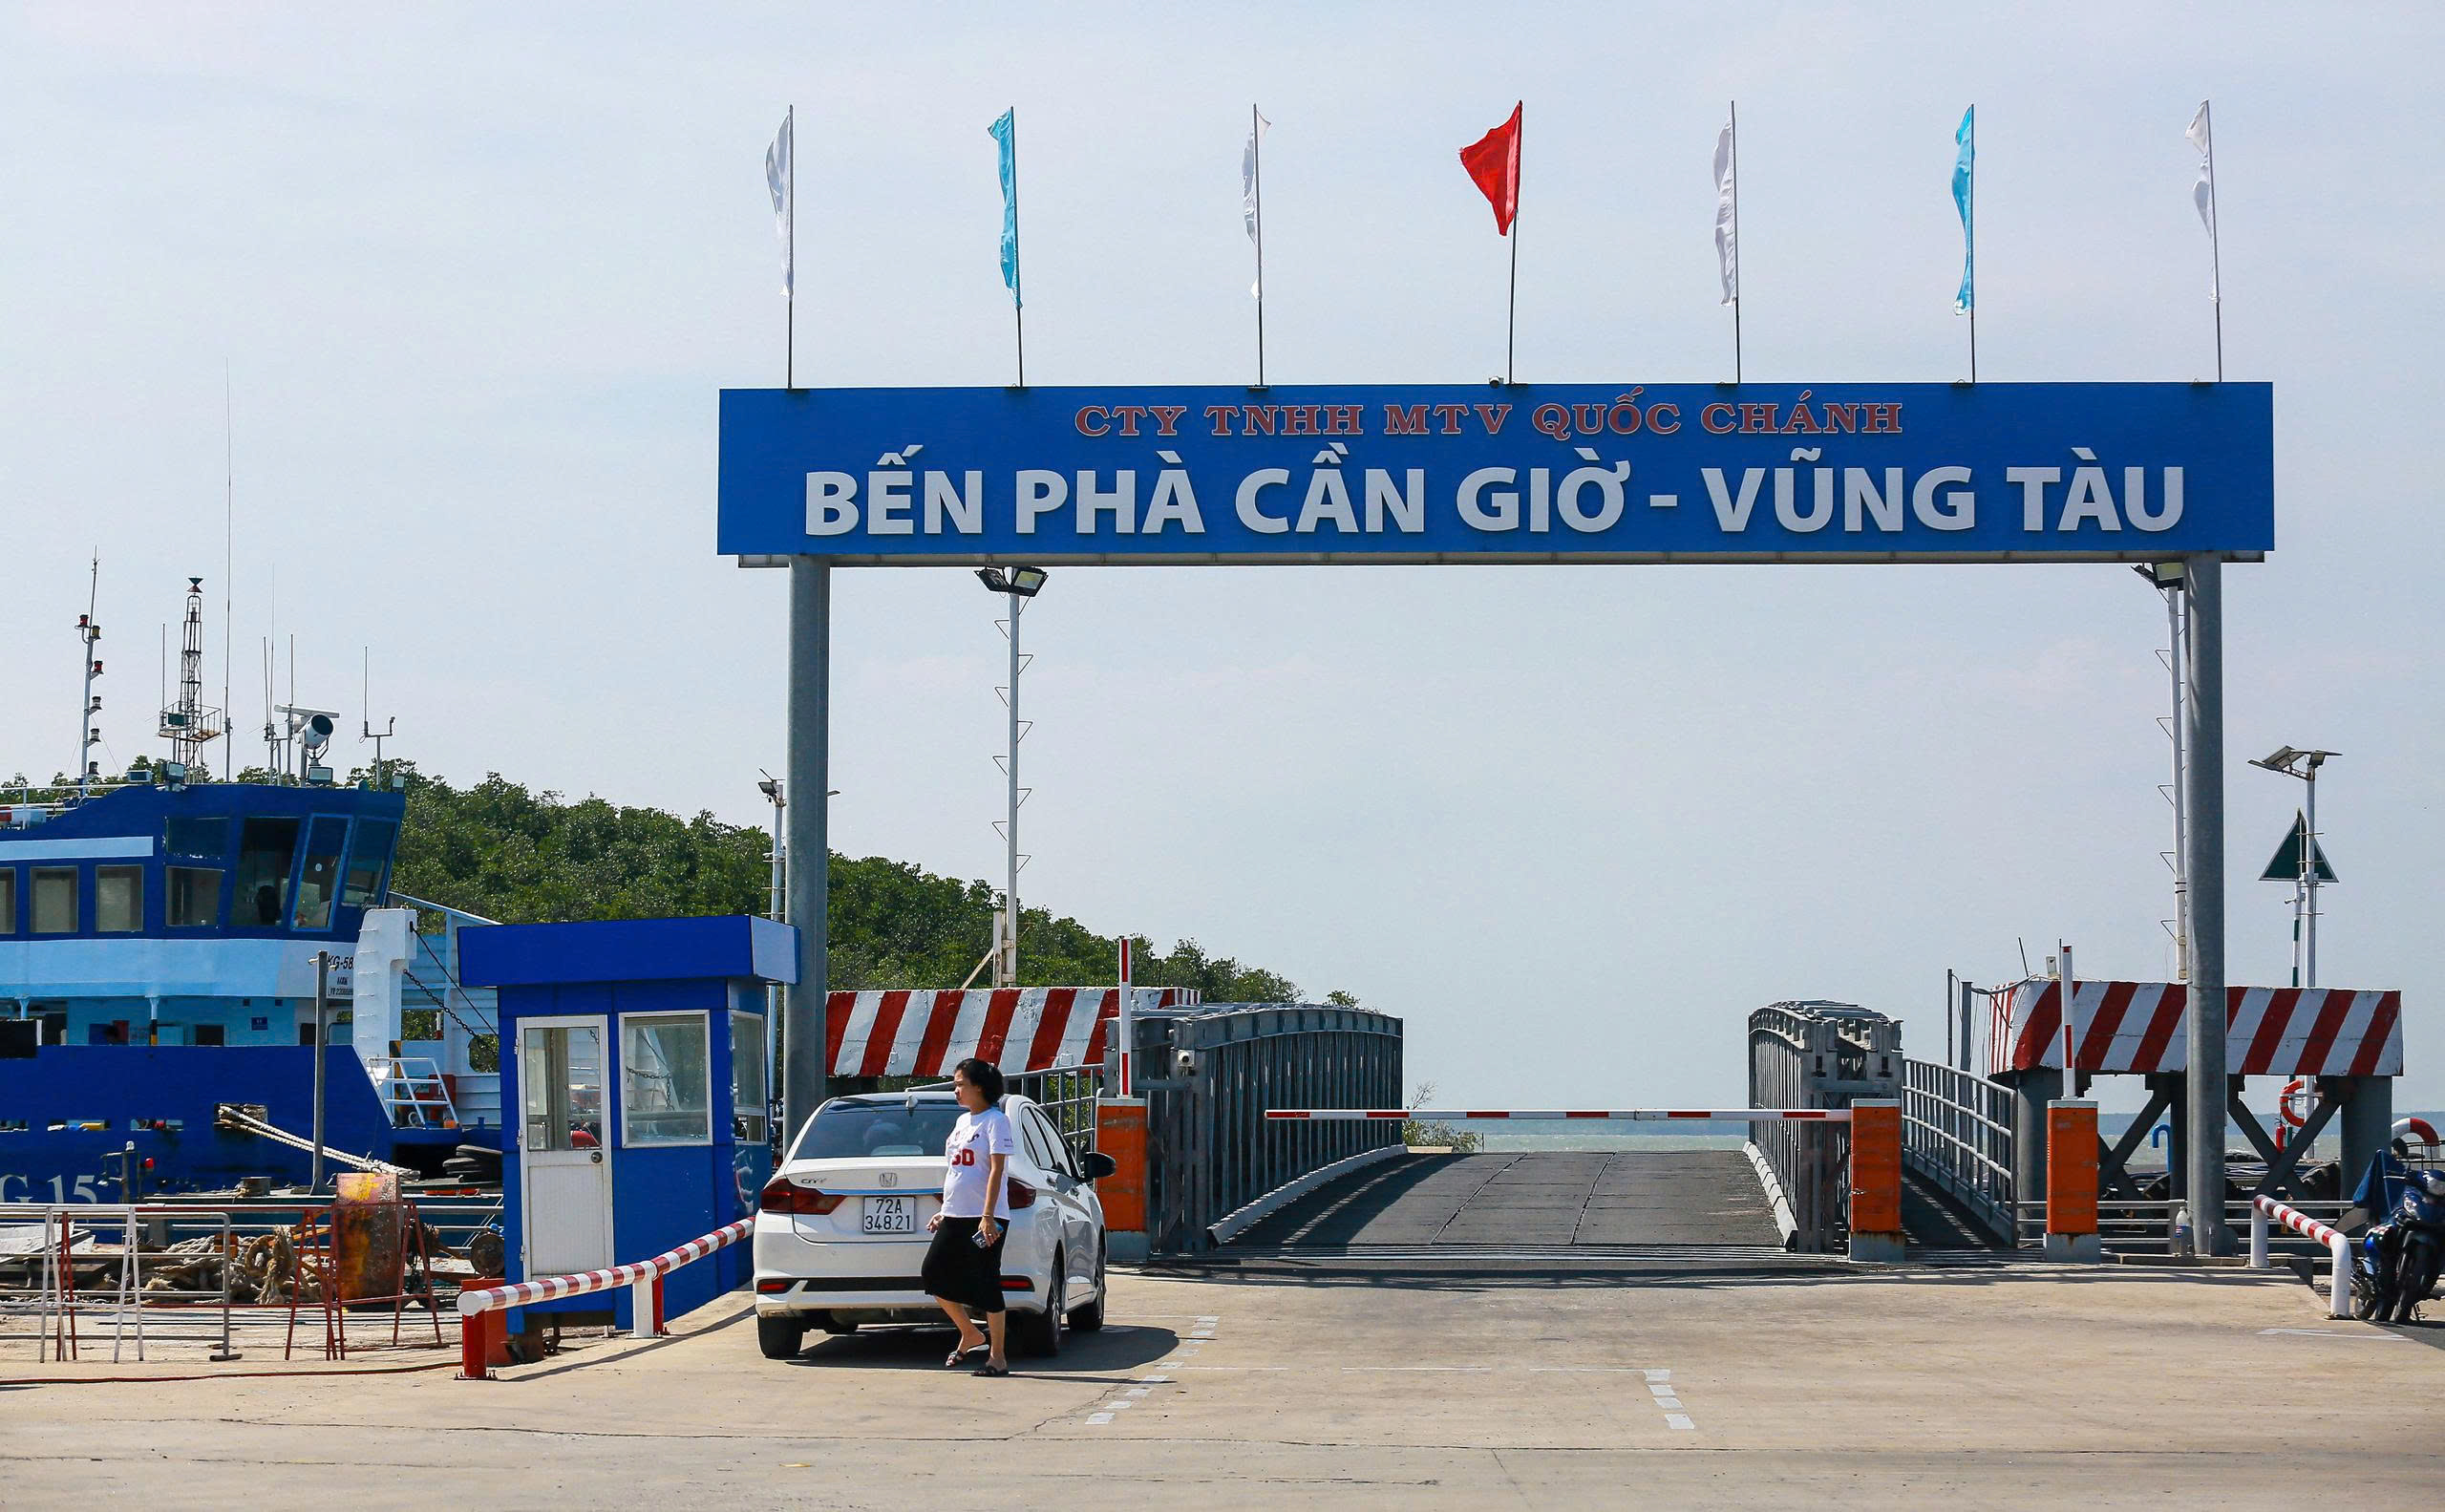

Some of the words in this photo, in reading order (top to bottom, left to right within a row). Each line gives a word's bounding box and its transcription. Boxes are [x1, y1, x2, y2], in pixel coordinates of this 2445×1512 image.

[1075, 406, 1186, 437] CTY
[1203, 405, 1364, 436] TNHH
[1383, 404, 1513, 435] MTV
[1532, 386, 1682, 441] QUỐC
[1700, 390, 1903, 435] CHÁNH
[805, 444, 983, 536] BẾN
[1015, 450, 1205, 535] PHÀ
[1235, 442, 1425, 534] CẦN
[1456, 447, 1631, 533] GIỜ
[1649, 494, 1678, 507] -
[1700, 447, 1976, 533] VŨNG
[2006, 447, 2184, 532] TÀU
[864, 1215, 911, 1230] 348.21
[876, 1199, 903, 1214] 72A
